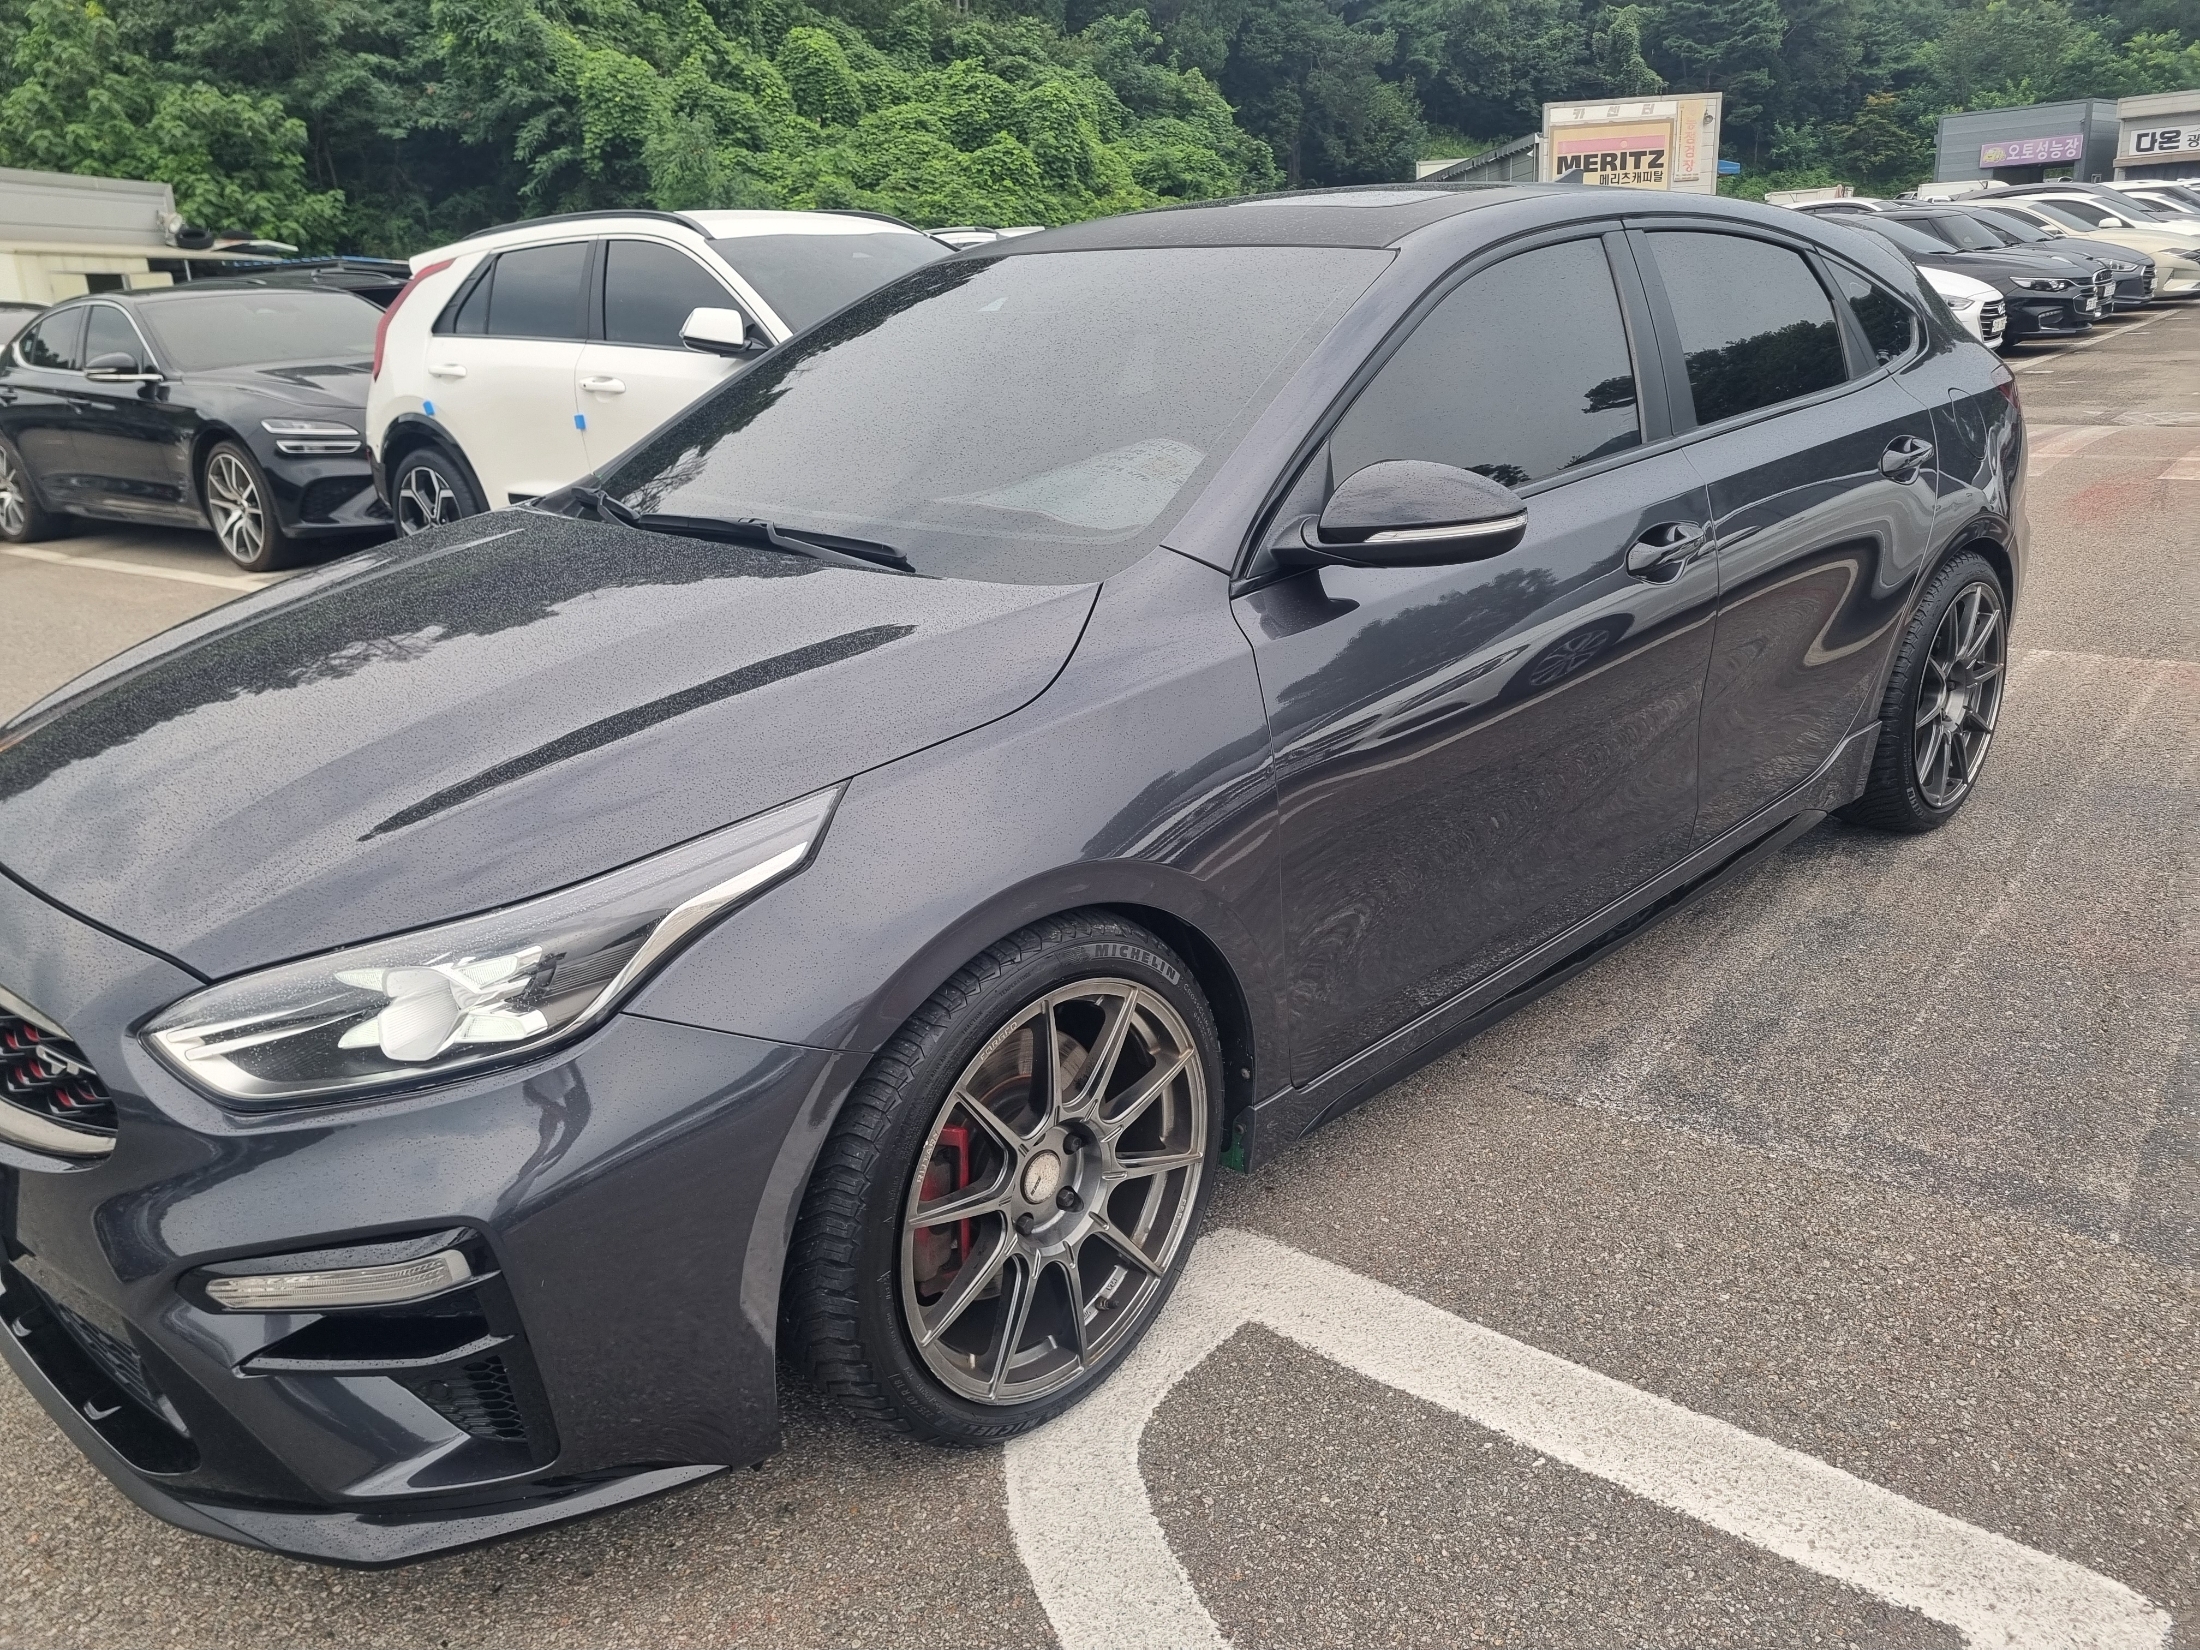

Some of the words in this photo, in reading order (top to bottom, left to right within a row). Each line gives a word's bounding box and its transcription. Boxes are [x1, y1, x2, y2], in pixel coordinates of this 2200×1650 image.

[2006, 138, 2080, 161] 오토성능장
[2136, 130, 2181, 152] 다온
[1556, 149, 1665, 175] MERITZ
[1600, 170, 1664, 185] 메리츠캐피탈
[1094, 943, 1176, 980] MICHELIN
